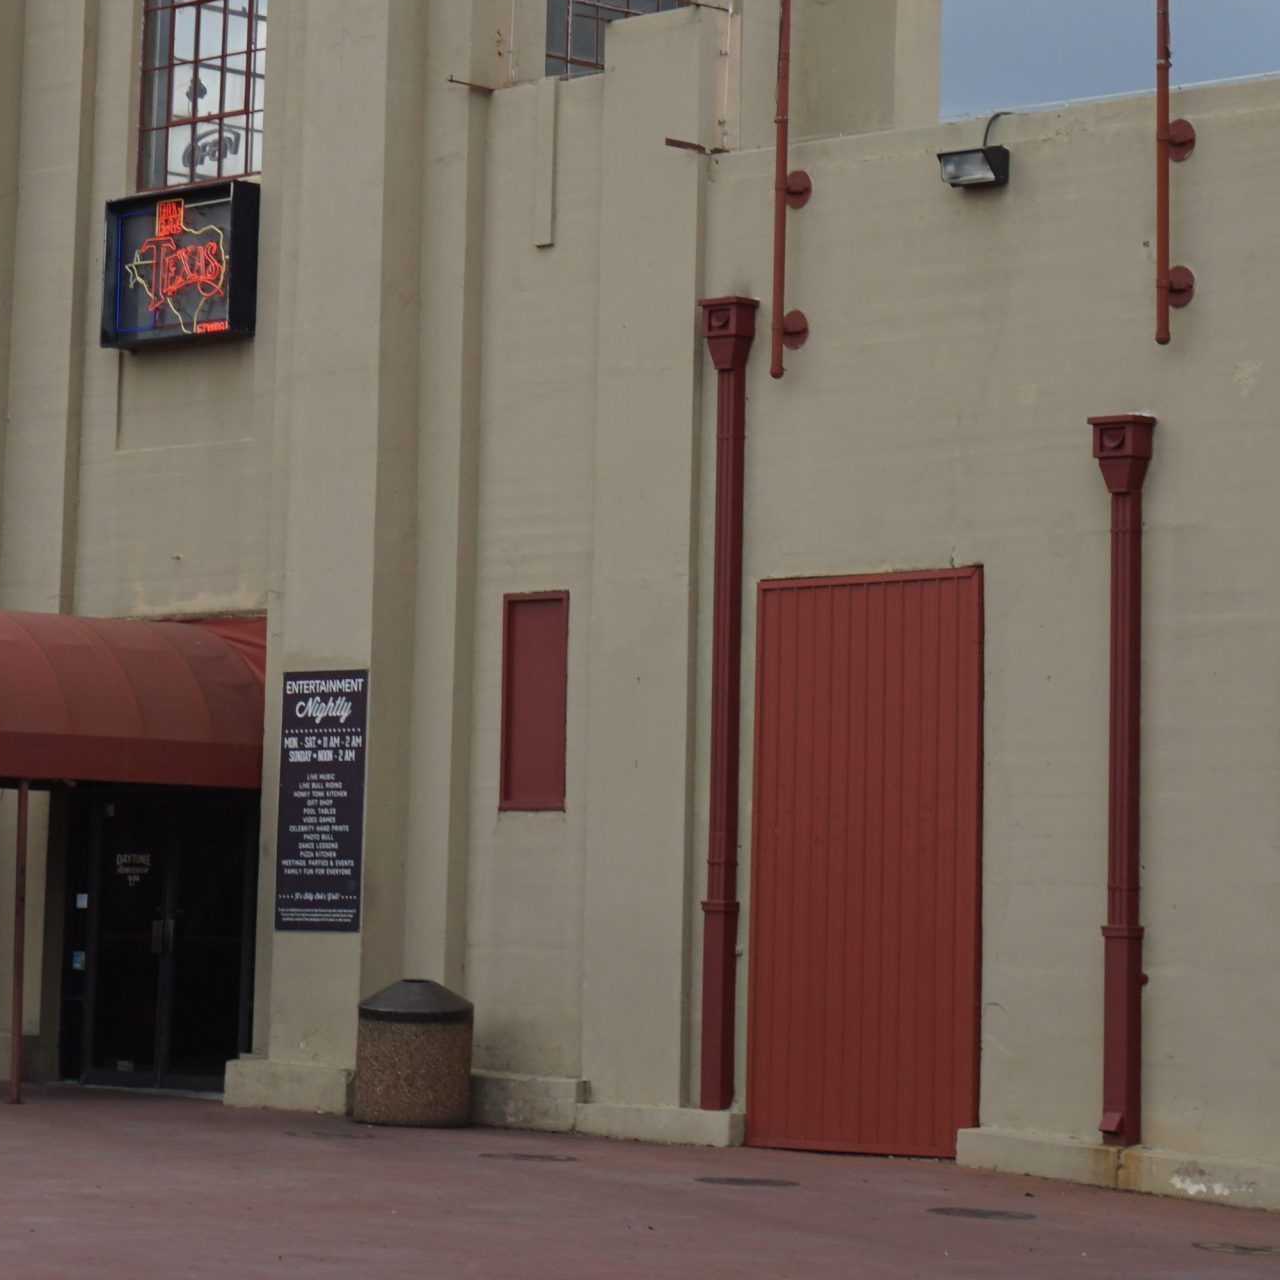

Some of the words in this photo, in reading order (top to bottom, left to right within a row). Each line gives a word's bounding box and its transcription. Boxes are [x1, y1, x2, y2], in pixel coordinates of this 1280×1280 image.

[286, 678, 364, 695] ENTERTAINMENT
[295, 696, 352, 724] Nightly
[329, 736, 340, 748] AM
[345, 736, 351, 748] 2
[351, 736, 362, 748] AM
[289, 750, 312, 762] SUNDAY
[338, 750, 343, 762] 2
[344, 750, 356, 762] AM
